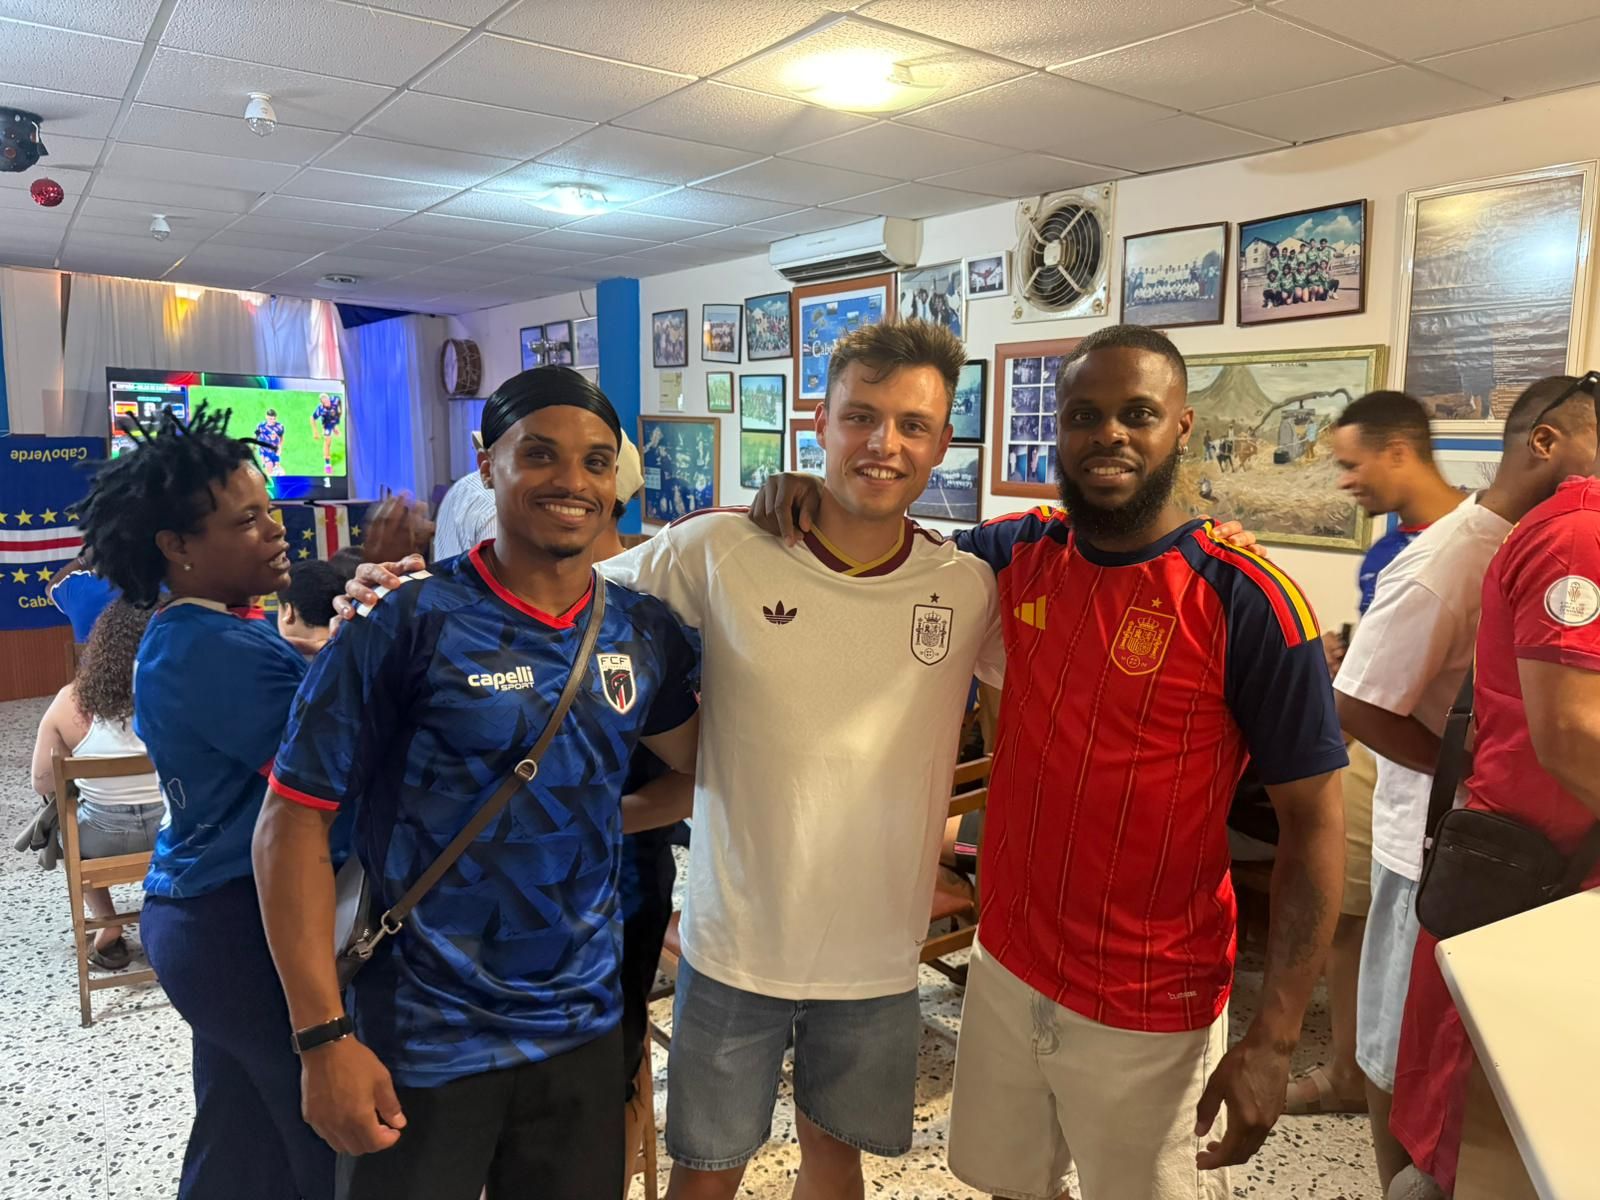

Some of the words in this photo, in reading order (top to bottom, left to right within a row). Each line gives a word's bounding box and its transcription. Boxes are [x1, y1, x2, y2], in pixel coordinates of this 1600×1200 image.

[10, 447, 88, 463] CaboVerde
[600, 656, 628, 666] FCF
[467, 666, 534, 690] capelli
[500, 681, 535, 692] SPORT
